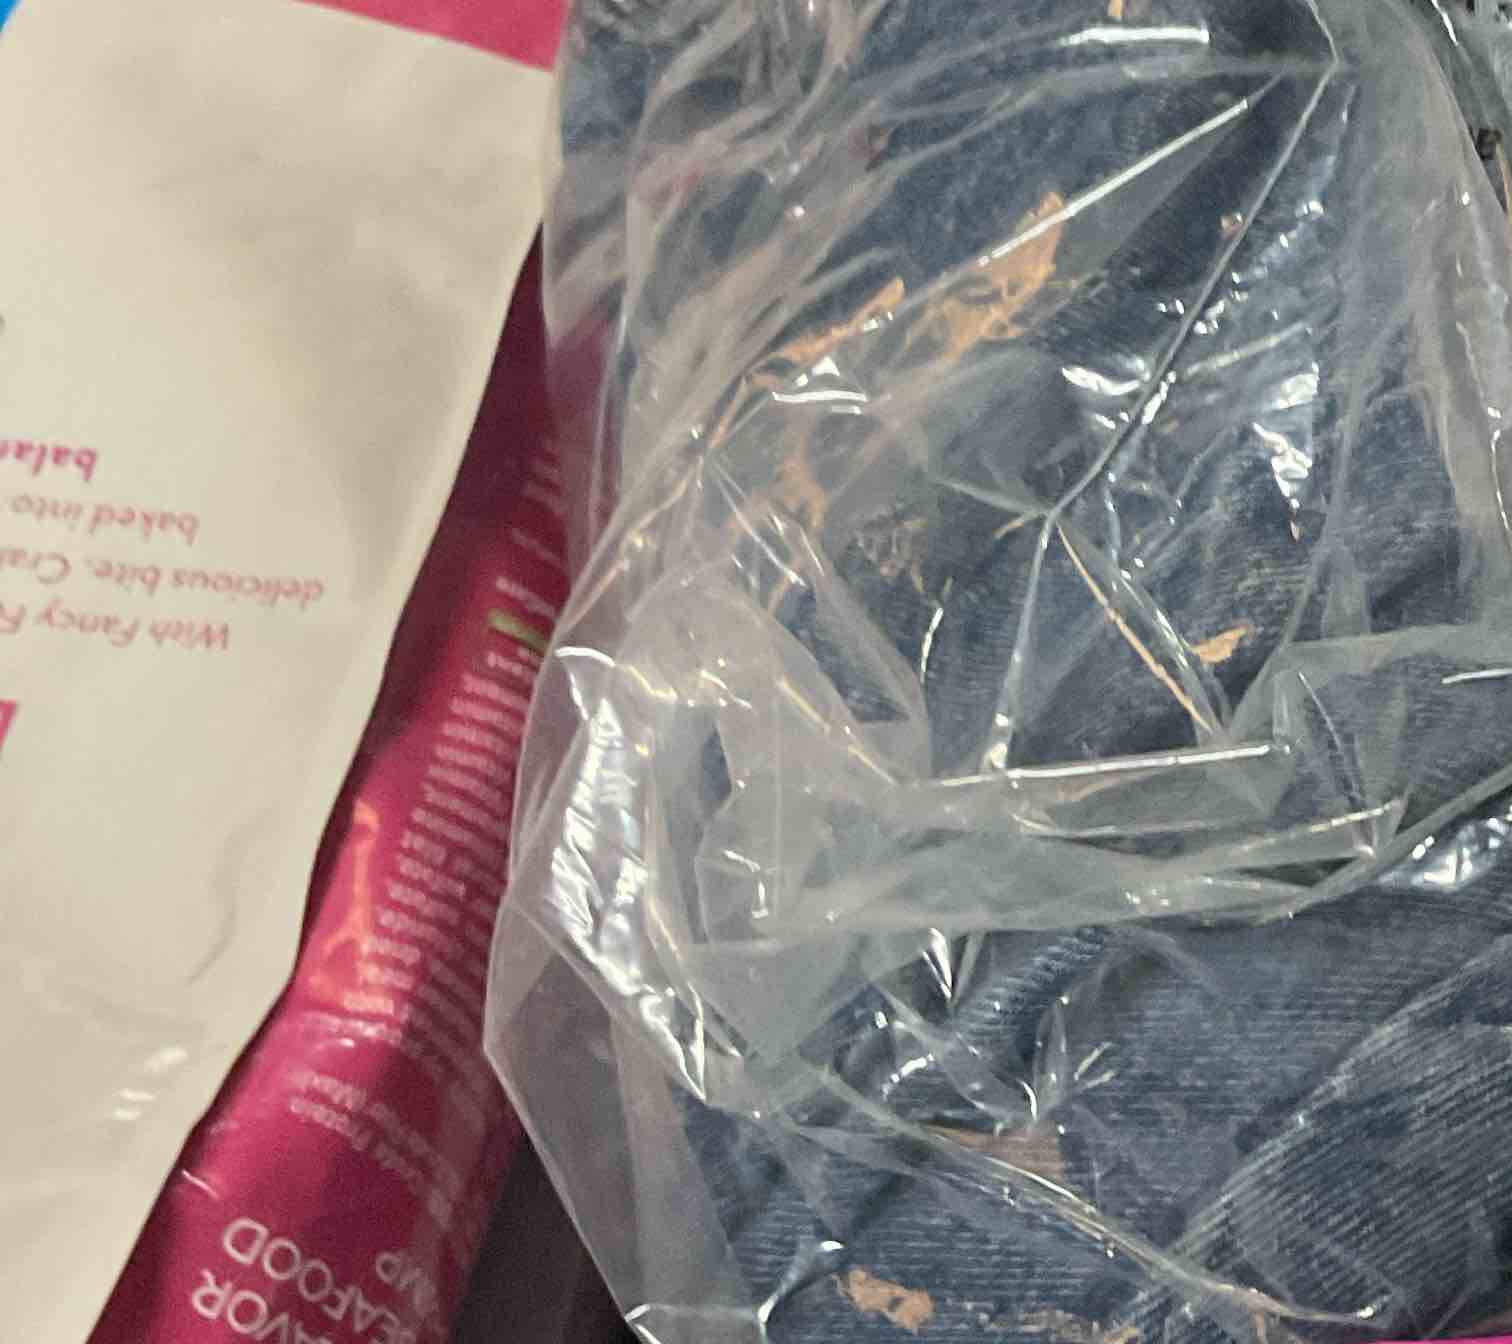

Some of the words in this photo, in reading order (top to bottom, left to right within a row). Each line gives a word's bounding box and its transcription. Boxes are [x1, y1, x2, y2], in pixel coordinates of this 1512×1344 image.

[12, 491, 88, 532] into
[94, 498, 200, 546] baked
[170, 566, 324, 612] delicious
